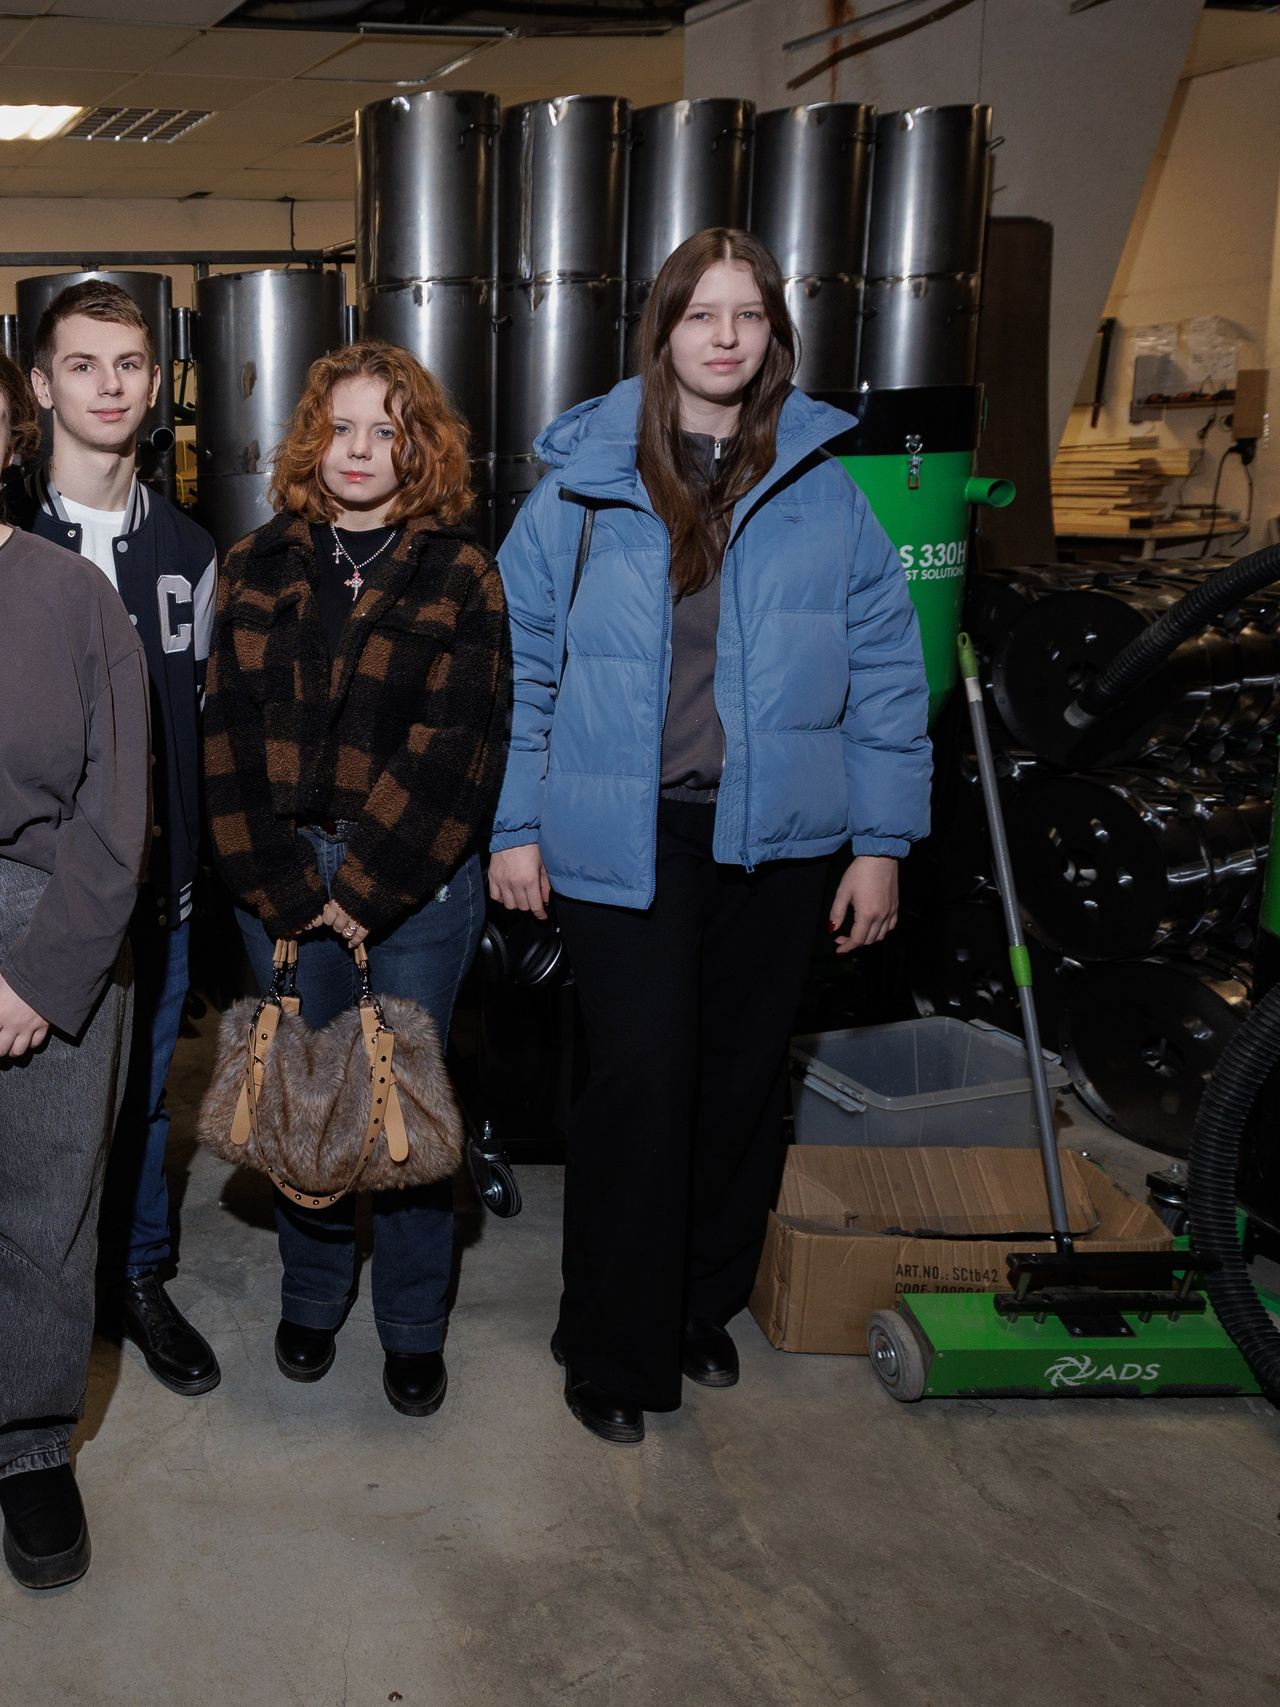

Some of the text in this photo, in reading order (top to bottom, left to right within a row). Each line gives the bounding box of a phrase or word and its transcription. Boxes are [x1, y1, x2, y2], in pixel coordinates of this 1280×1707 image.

[899, 540, 967, 568] S 330H
[905, 565, 965, 581] ST SOLUTIONS
[156, 574, 193, 655] C
[952, 1267, 999, 1283] SCtb42
[1094, 1363, 1161, 1381] ADS
